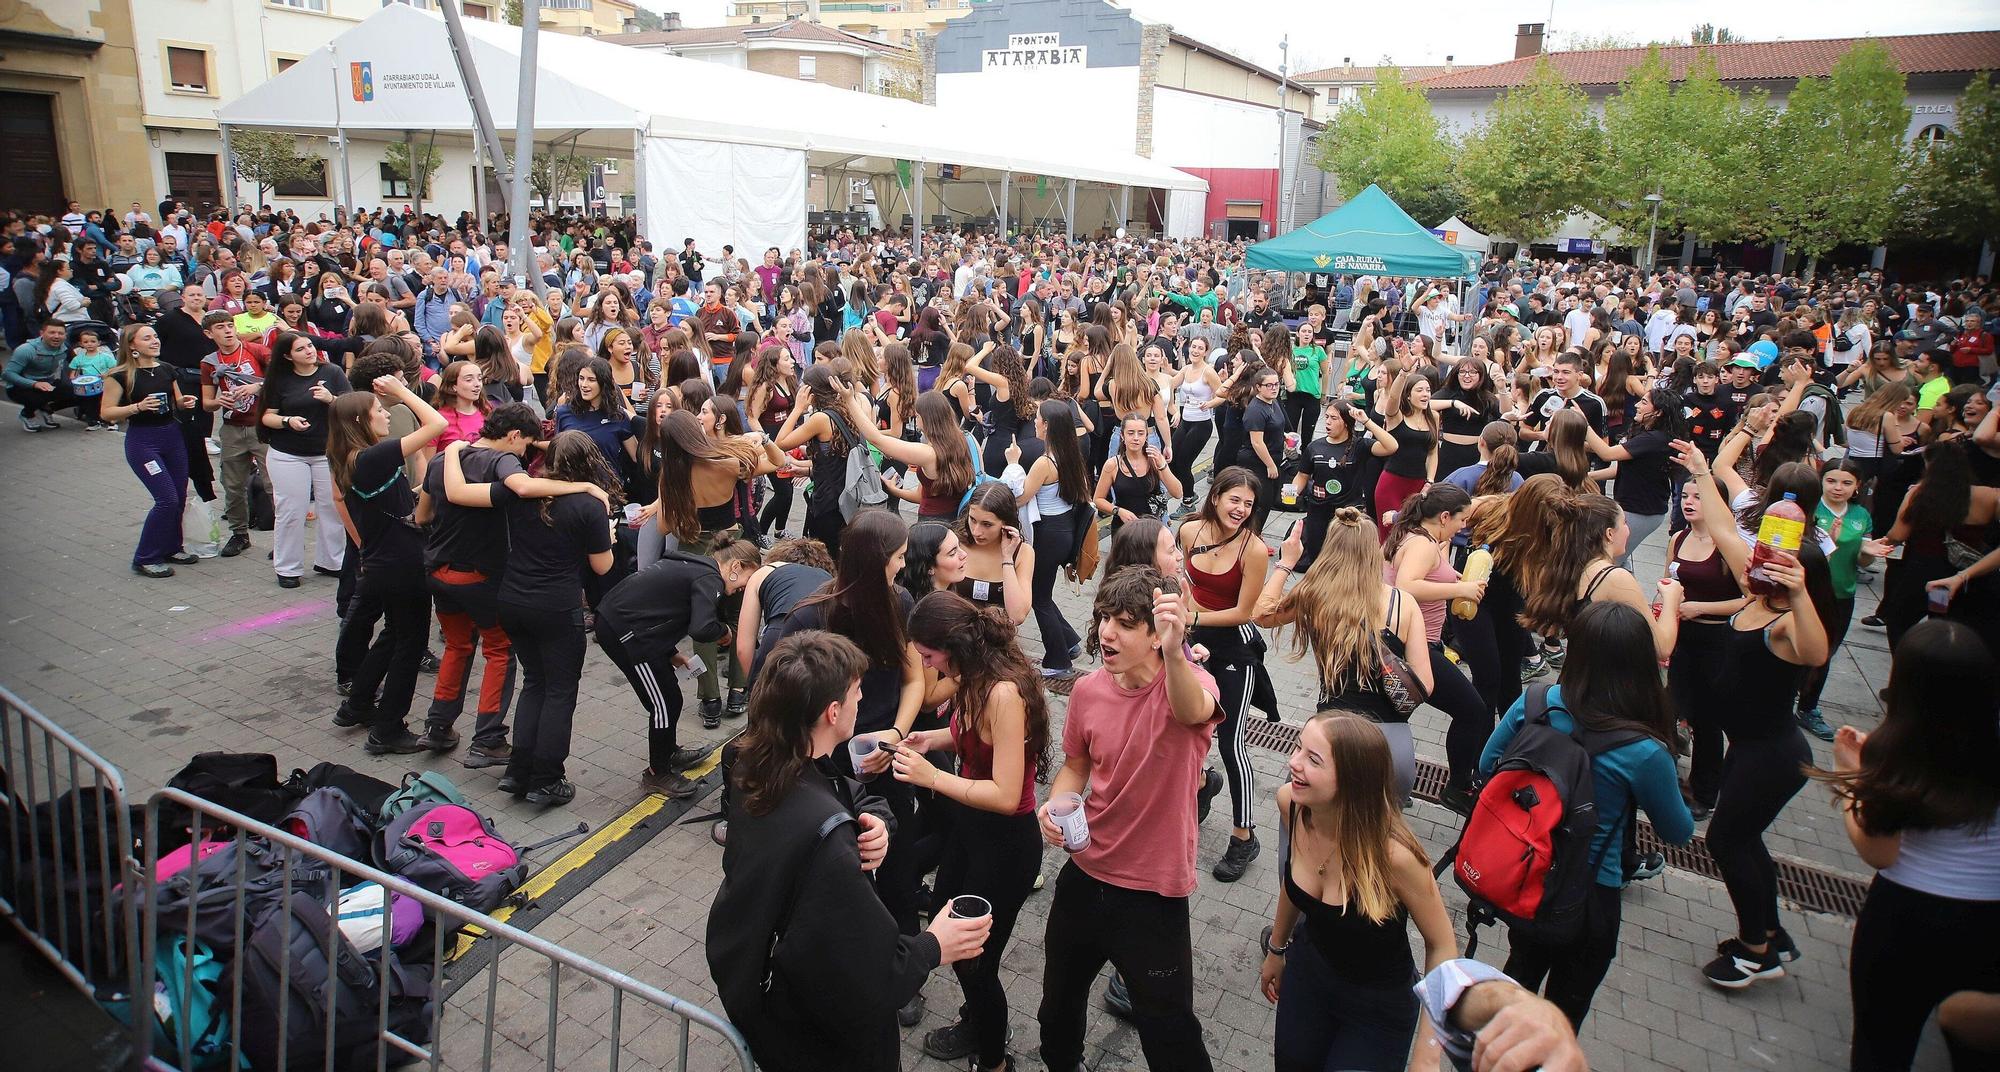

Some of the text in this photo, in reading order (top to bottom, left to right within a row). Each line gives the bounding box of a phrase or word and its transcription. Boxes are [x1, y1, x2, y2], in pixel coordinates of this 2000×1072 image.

[1011, 35, 1058, 46] FRONTON
[383, 73, 440, 81] ATARRABIAKO UDALA
[383, 81, 423, 90] AYUNTAMIENTO
[433, 81, 456, 89] VILLAVA
[1915, 104, 1953, 114] ETXEA
[1335, 255, 1383, 264] CAJA RURAL
[1346, 263, 1387, 271] NAVARRA
